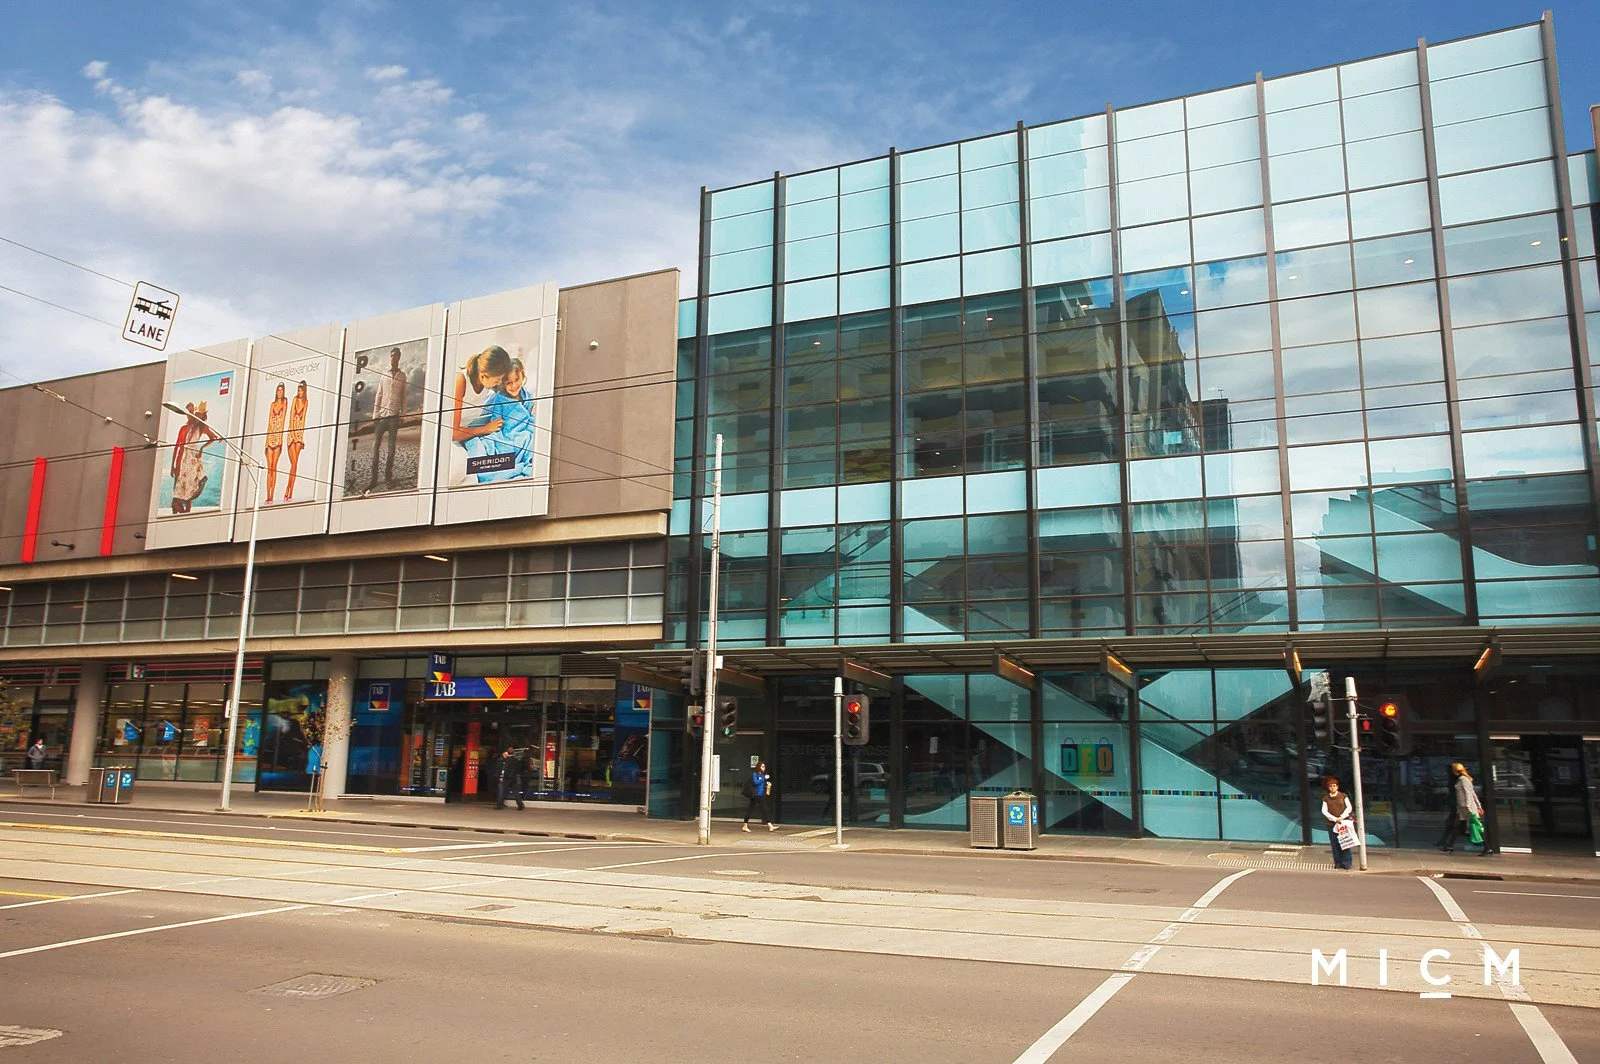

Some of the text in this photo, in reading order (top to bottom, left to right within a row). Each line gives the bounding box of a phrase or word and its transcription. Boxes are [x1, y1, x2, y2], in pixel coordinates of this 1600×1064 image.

[129, 319, 165, 342] LANE
[433, 654, 447, 665] TAB
[372, 686, 384, 695] TAB
[434, 681, 456, 697] TAB
[1062, 746, 1113, 773] DFO
